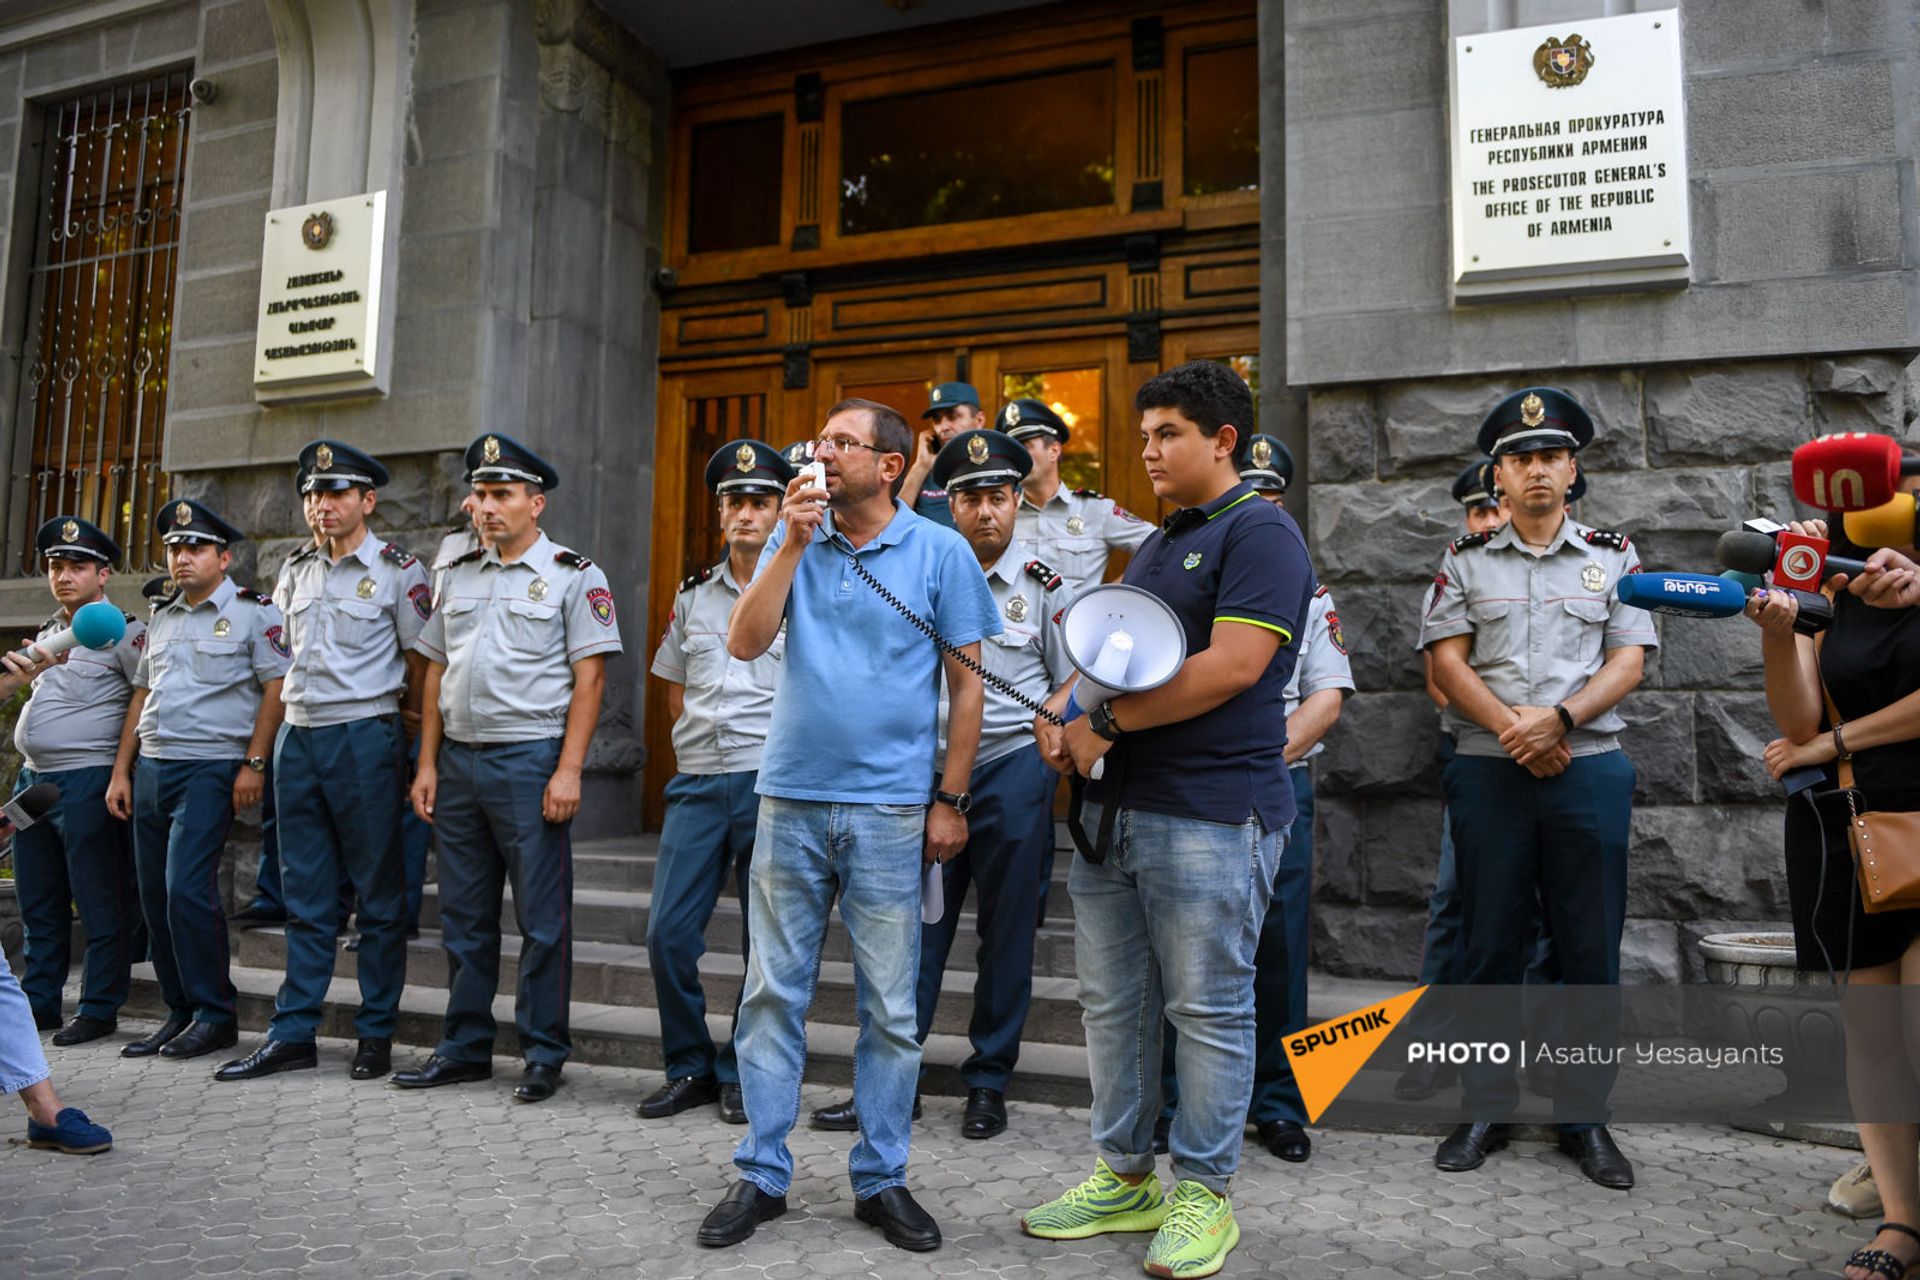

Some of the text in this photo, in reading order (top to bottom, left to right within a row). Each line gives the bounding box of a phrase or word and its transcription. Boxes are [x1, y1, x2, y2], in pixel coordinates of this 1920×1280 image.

[1470, 109, 1665, 144] ГЕНЕРАЛЬНАЯ ПРОКУРАТУРА
[1488, 135, 1648, 165] РЕСПУБЛИКИ АРМЕНИЯ
[1472, 162, 1667, 196] THE PROSECUTOR GENERAL'S
[1485, 188, 1655, 219] OFFICE OF THE REPUBLIC
[1527, 216, 1613, 238] OF ARMENIA
